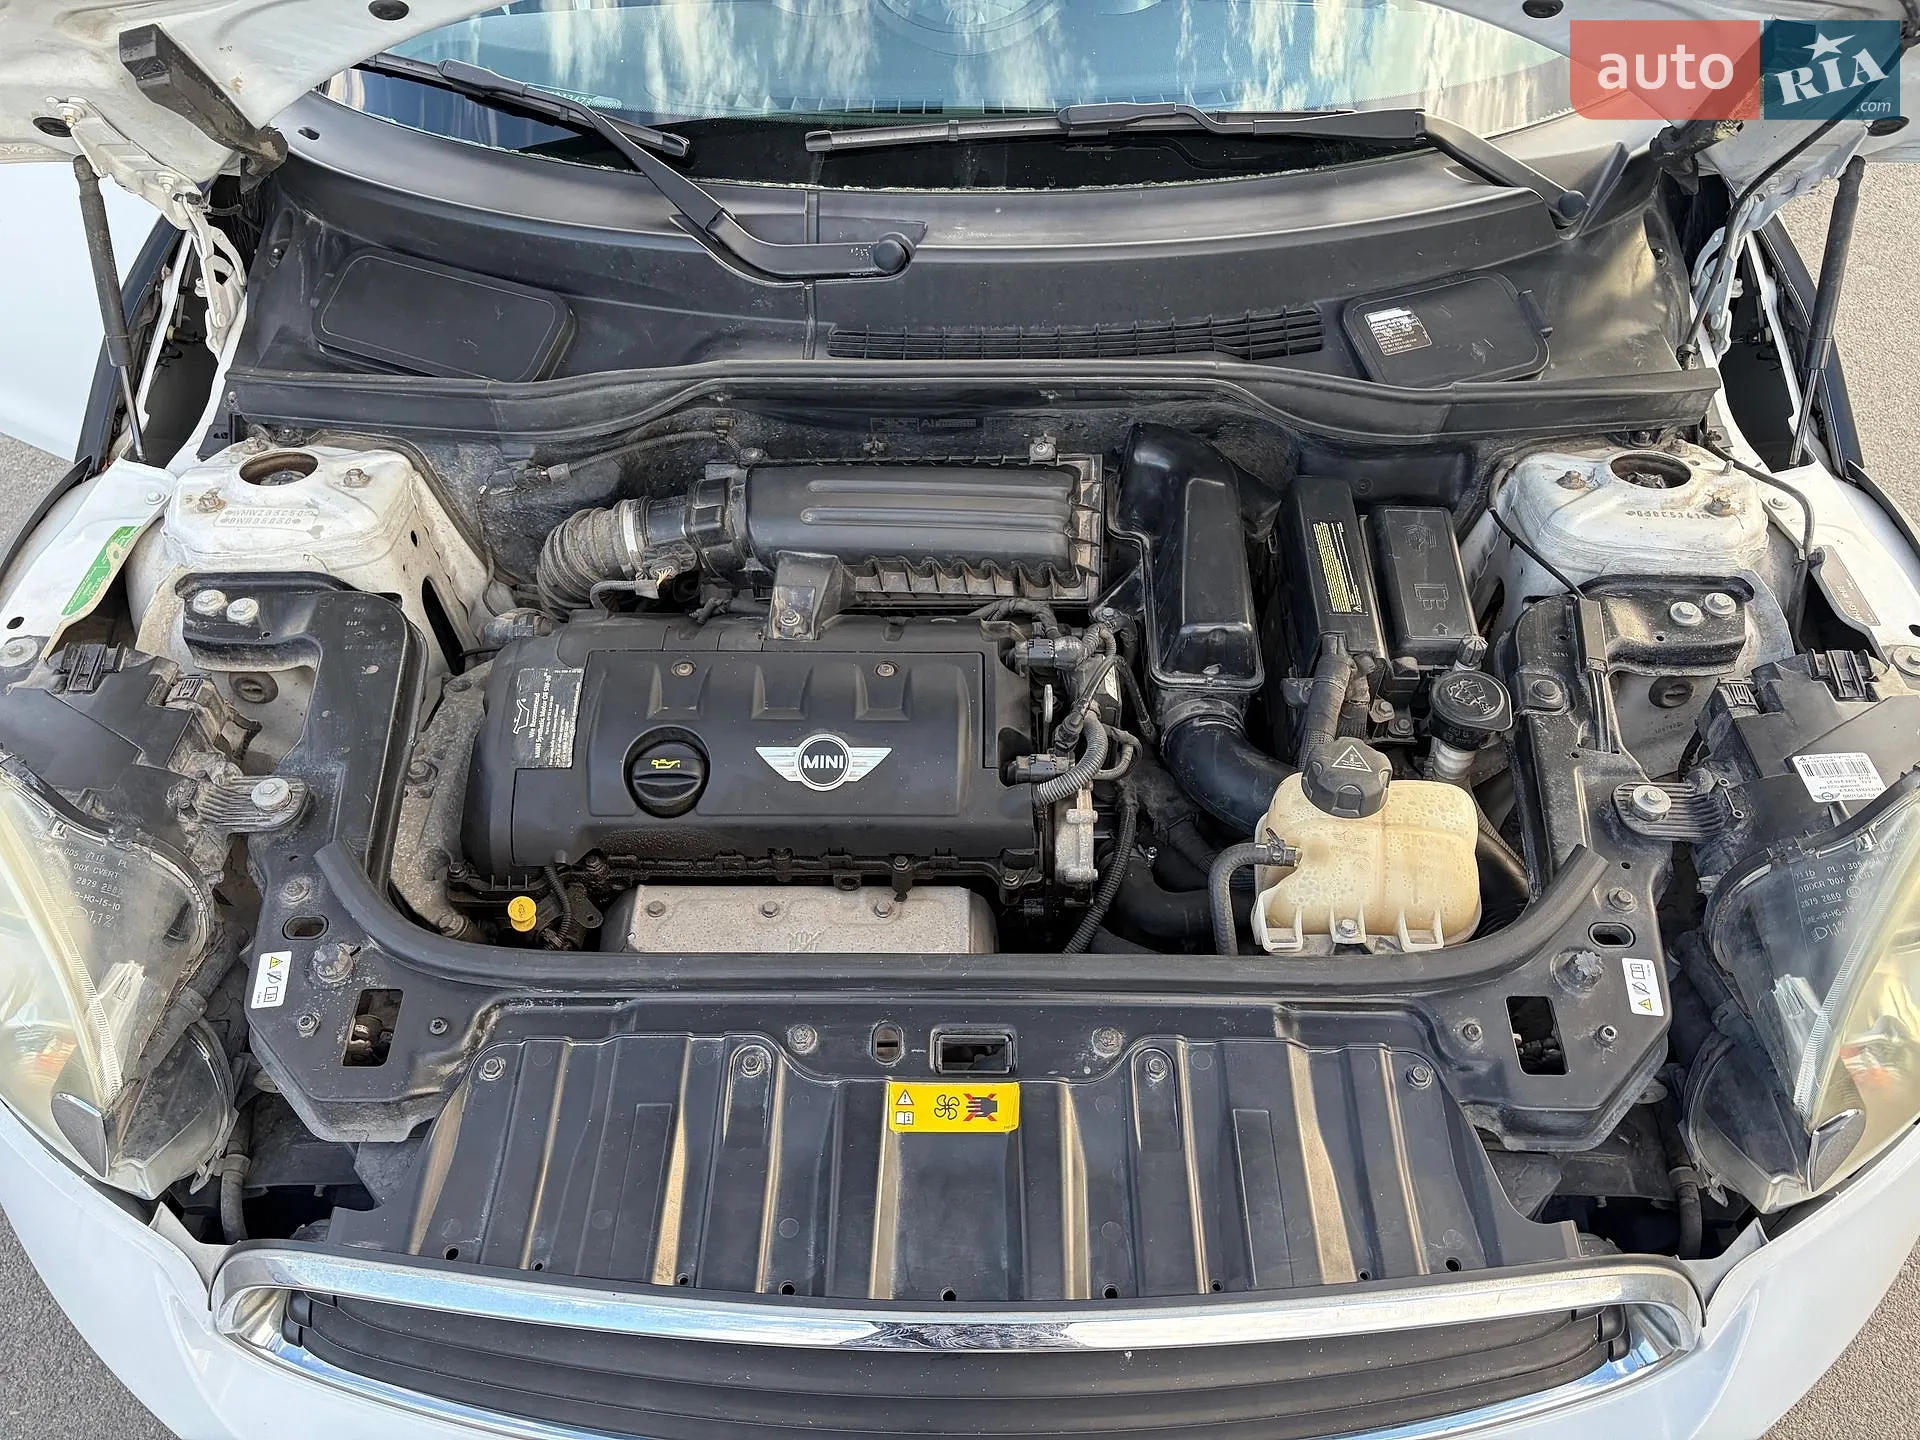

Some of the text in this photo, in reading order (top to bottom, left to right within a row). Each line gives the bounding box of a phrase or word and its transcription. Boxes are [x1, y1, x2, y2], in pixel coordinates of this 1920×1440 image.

[528, 728, 536, 738] We
[804, 754, 844, 768] MINI
[118, 859, 129, 869] PL
